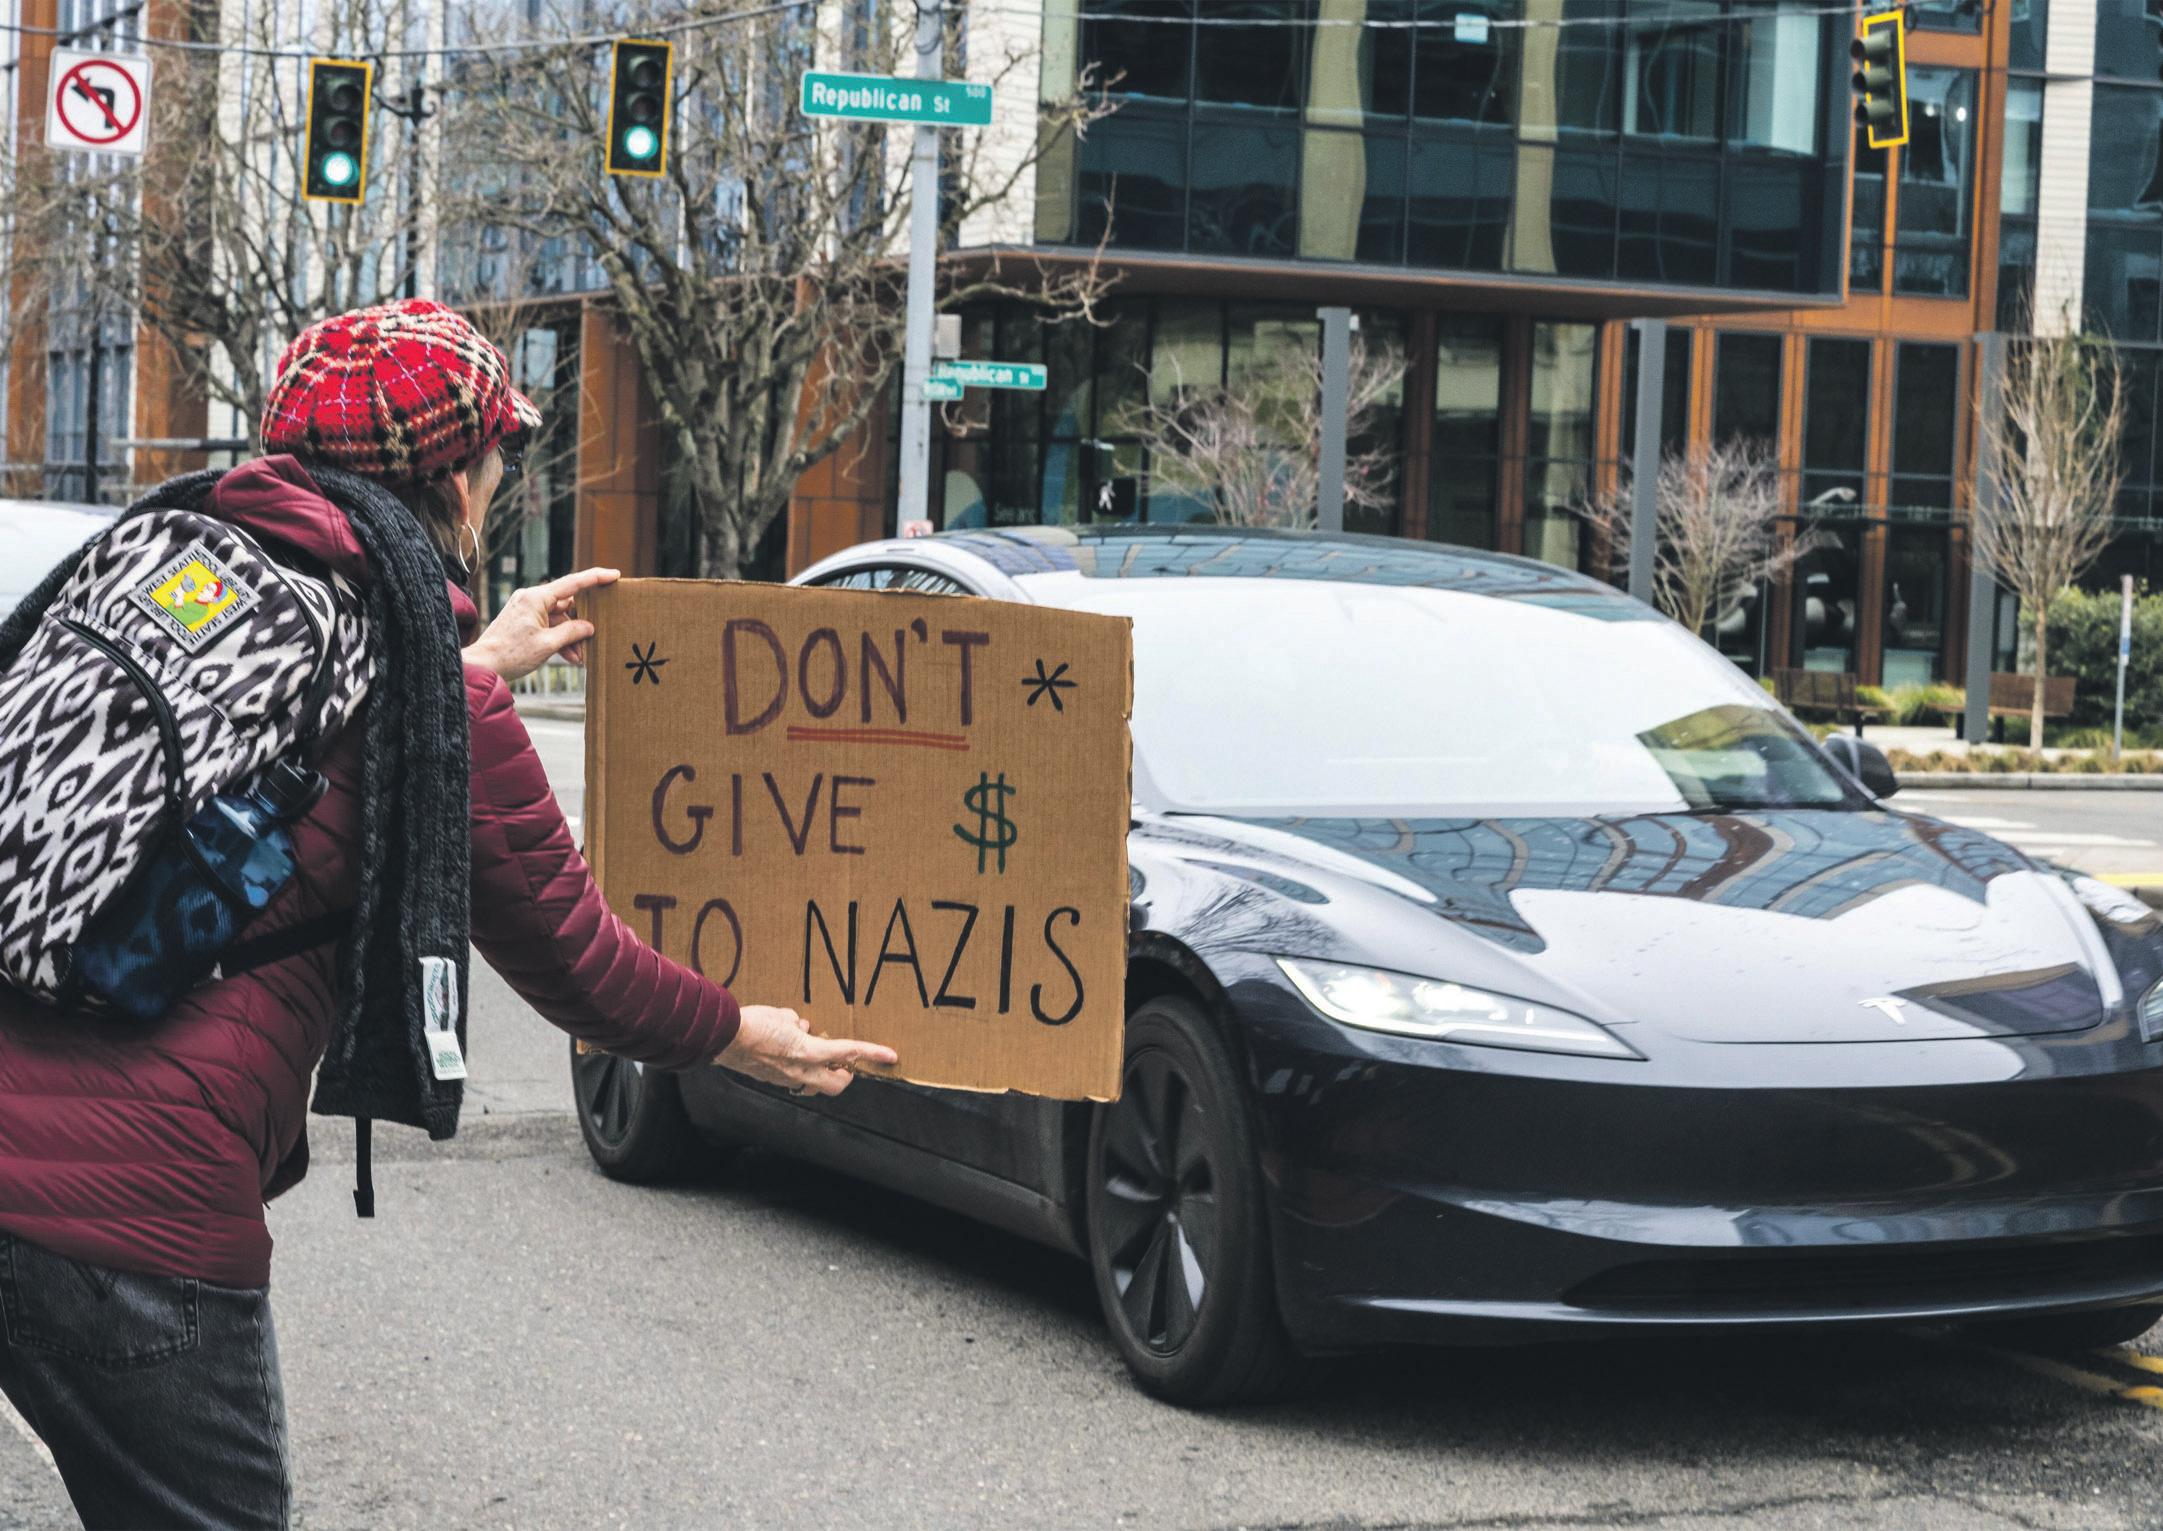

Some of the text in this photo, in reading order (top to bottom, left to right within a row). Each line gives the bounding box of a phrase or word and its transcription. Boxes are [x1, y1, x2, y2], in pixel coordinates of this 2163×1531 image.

[812, 81, 951, 113] Republican St
[143, 575, 168, 595] WEST
[722, 616, 990, 736] DON'T
[651, 765, 1018, 874] GIVE $
[634, 894, 1085, 1026] TO NAZIS
